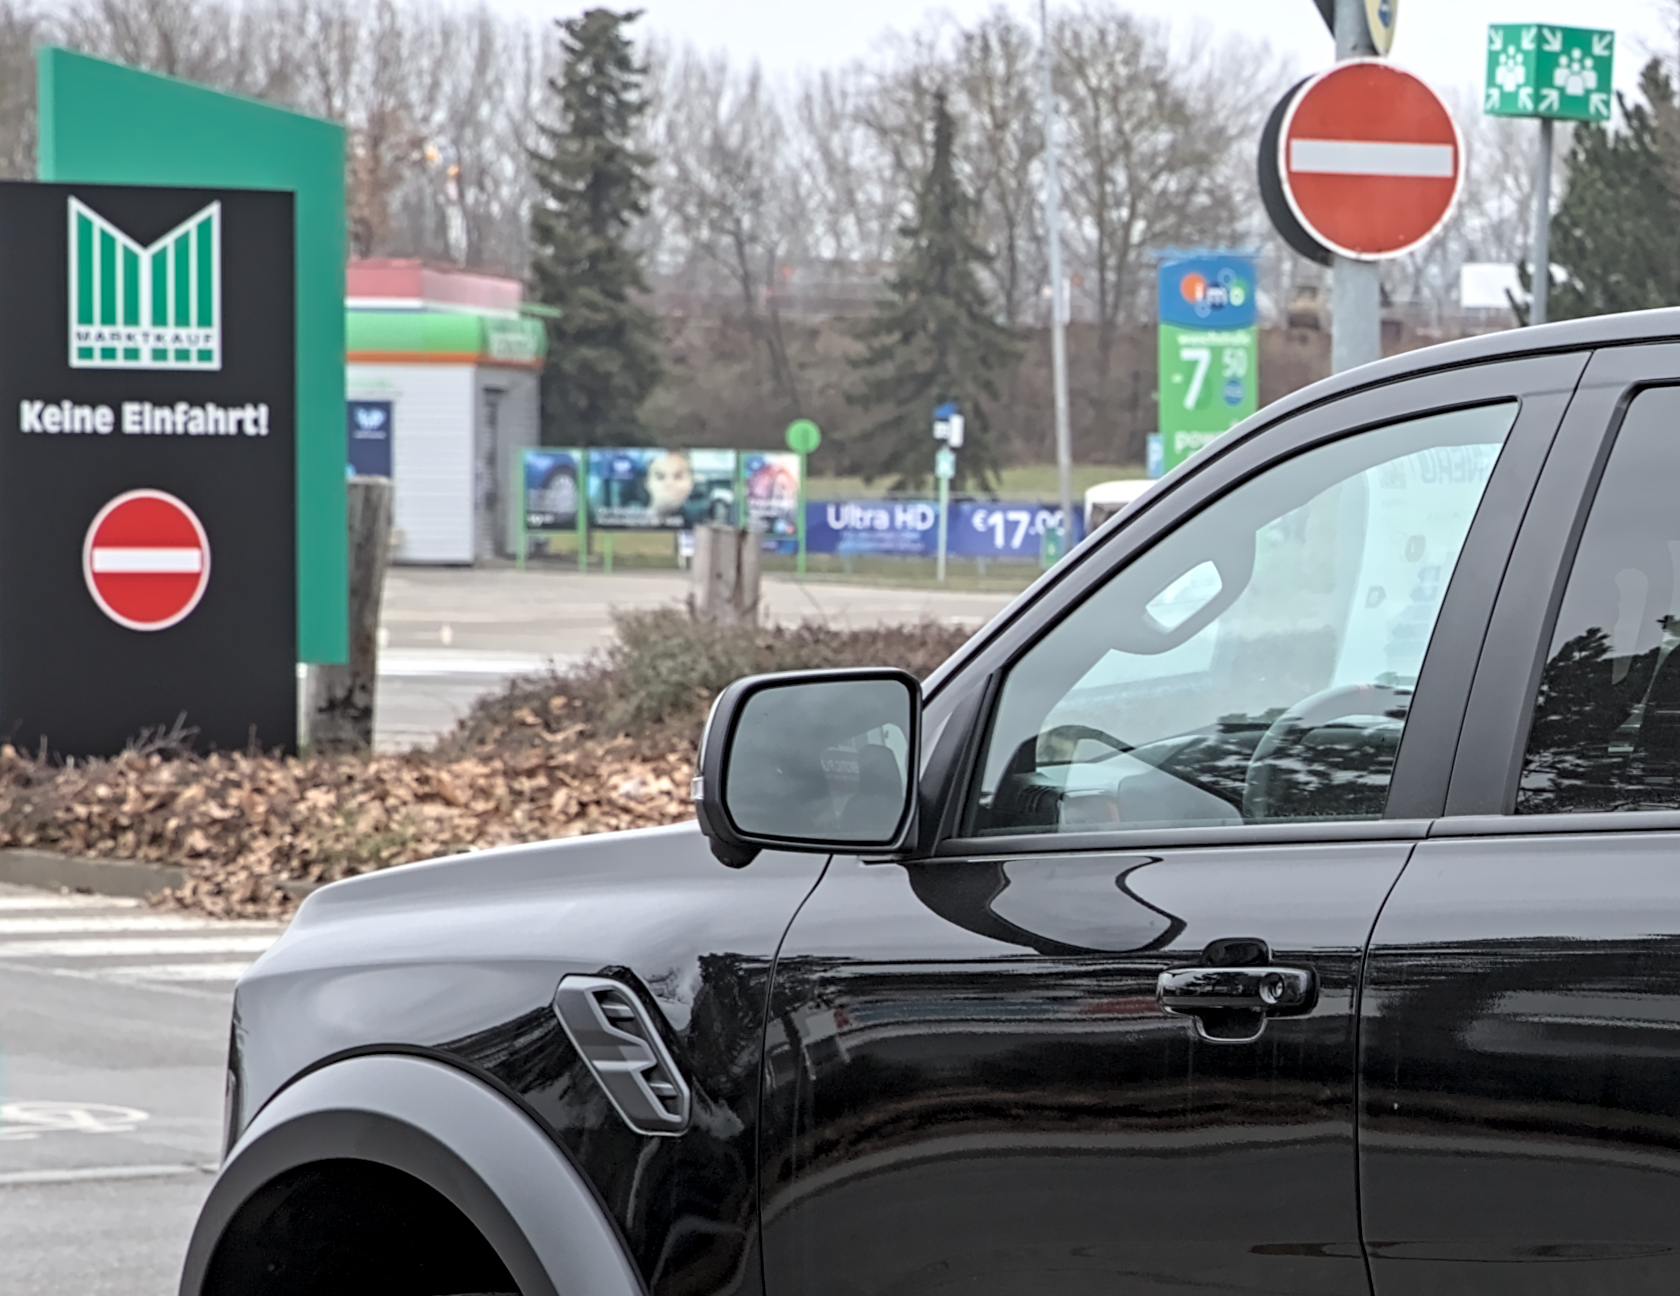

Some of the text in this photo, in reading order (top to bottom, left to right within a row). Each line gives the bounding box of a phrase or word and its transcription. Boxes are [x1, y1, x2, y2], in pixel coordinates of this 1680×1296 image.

[76, 331, 214, 344] MARKTKAUF
[20, 399, 269, 436] Keine Einfahrt!
[826, 503, 935, 531] Ultra HD
